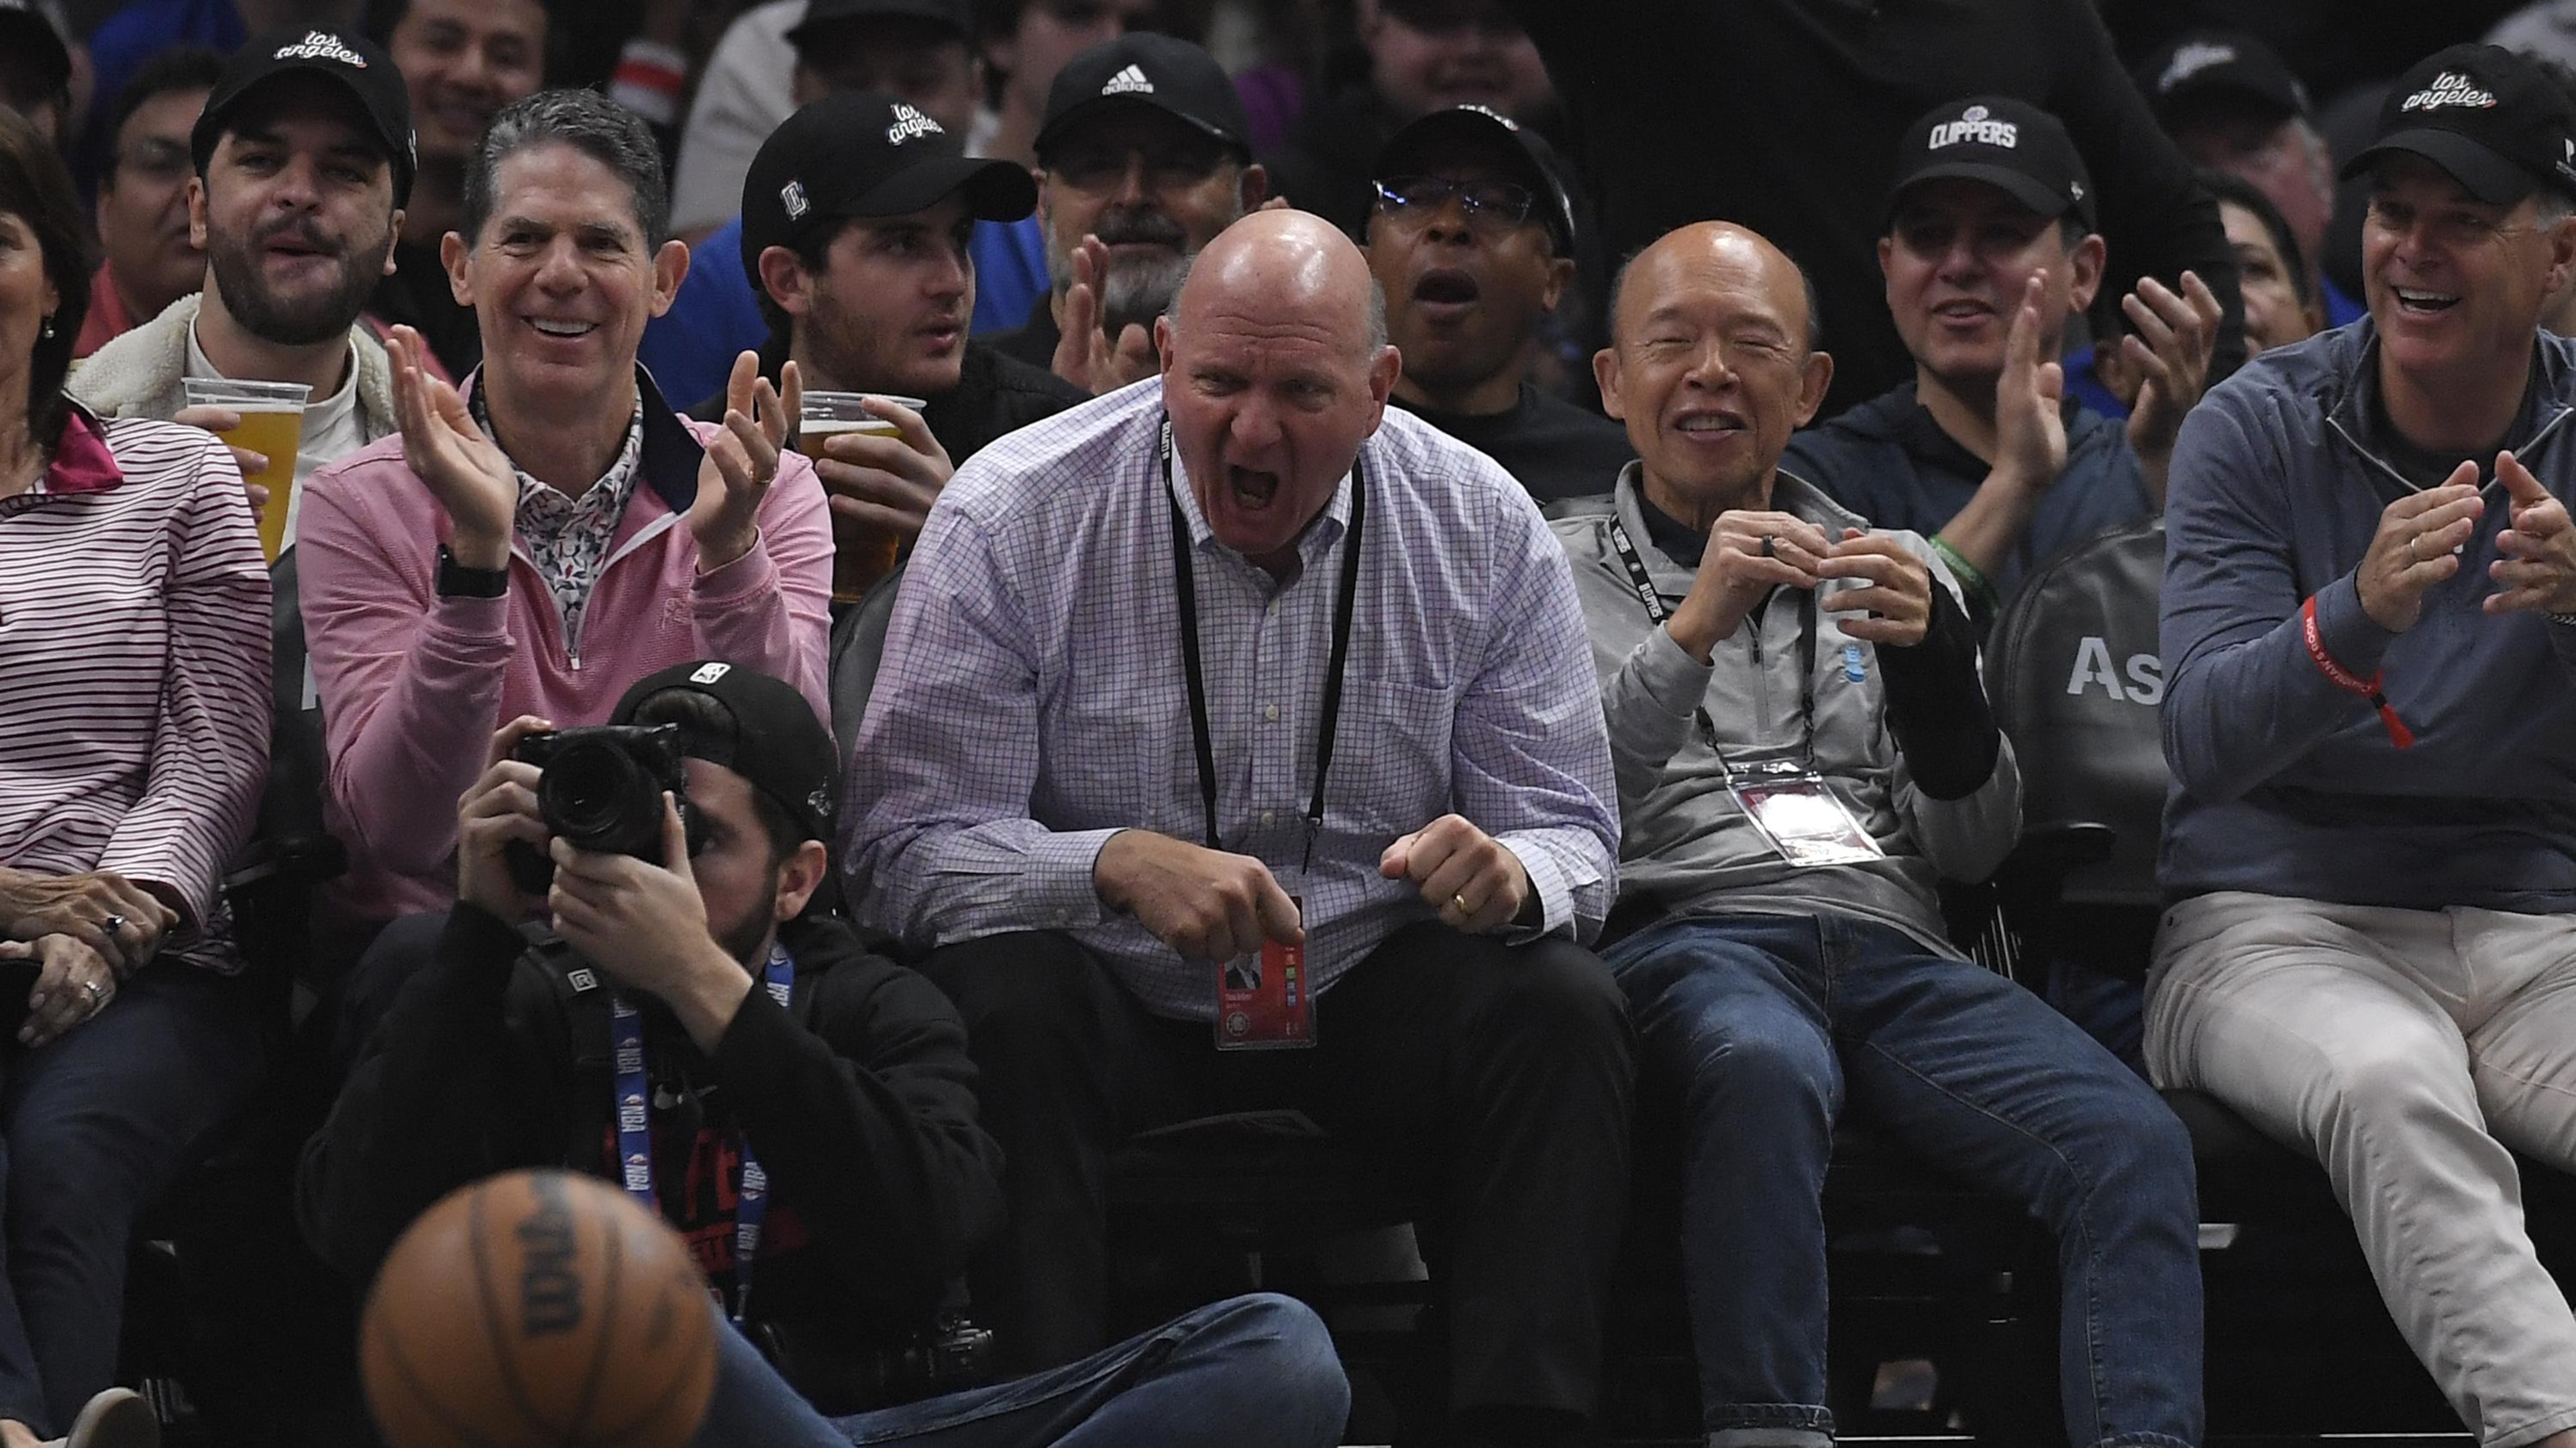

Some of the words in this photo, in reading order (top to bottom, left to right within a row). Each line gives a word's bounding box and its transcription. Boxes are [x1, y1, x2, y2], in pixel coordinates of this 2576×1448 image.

[305, 30, 342, 46] los
[274, 44, 363, 65] angeles
[2431, 72, 2471, 91] los
[892, 103, 920, 122] los
[2402, 88, 2494, 112] angeles
[1929, 120, 2017, 150] CLIPPERS
[617, 1047, 642, 1074] NBA
[621, 1104, 646, 1133] NBA
[625, 1164, 651, 1192] NBA
[743, 1161, 767, 1192] NBA
